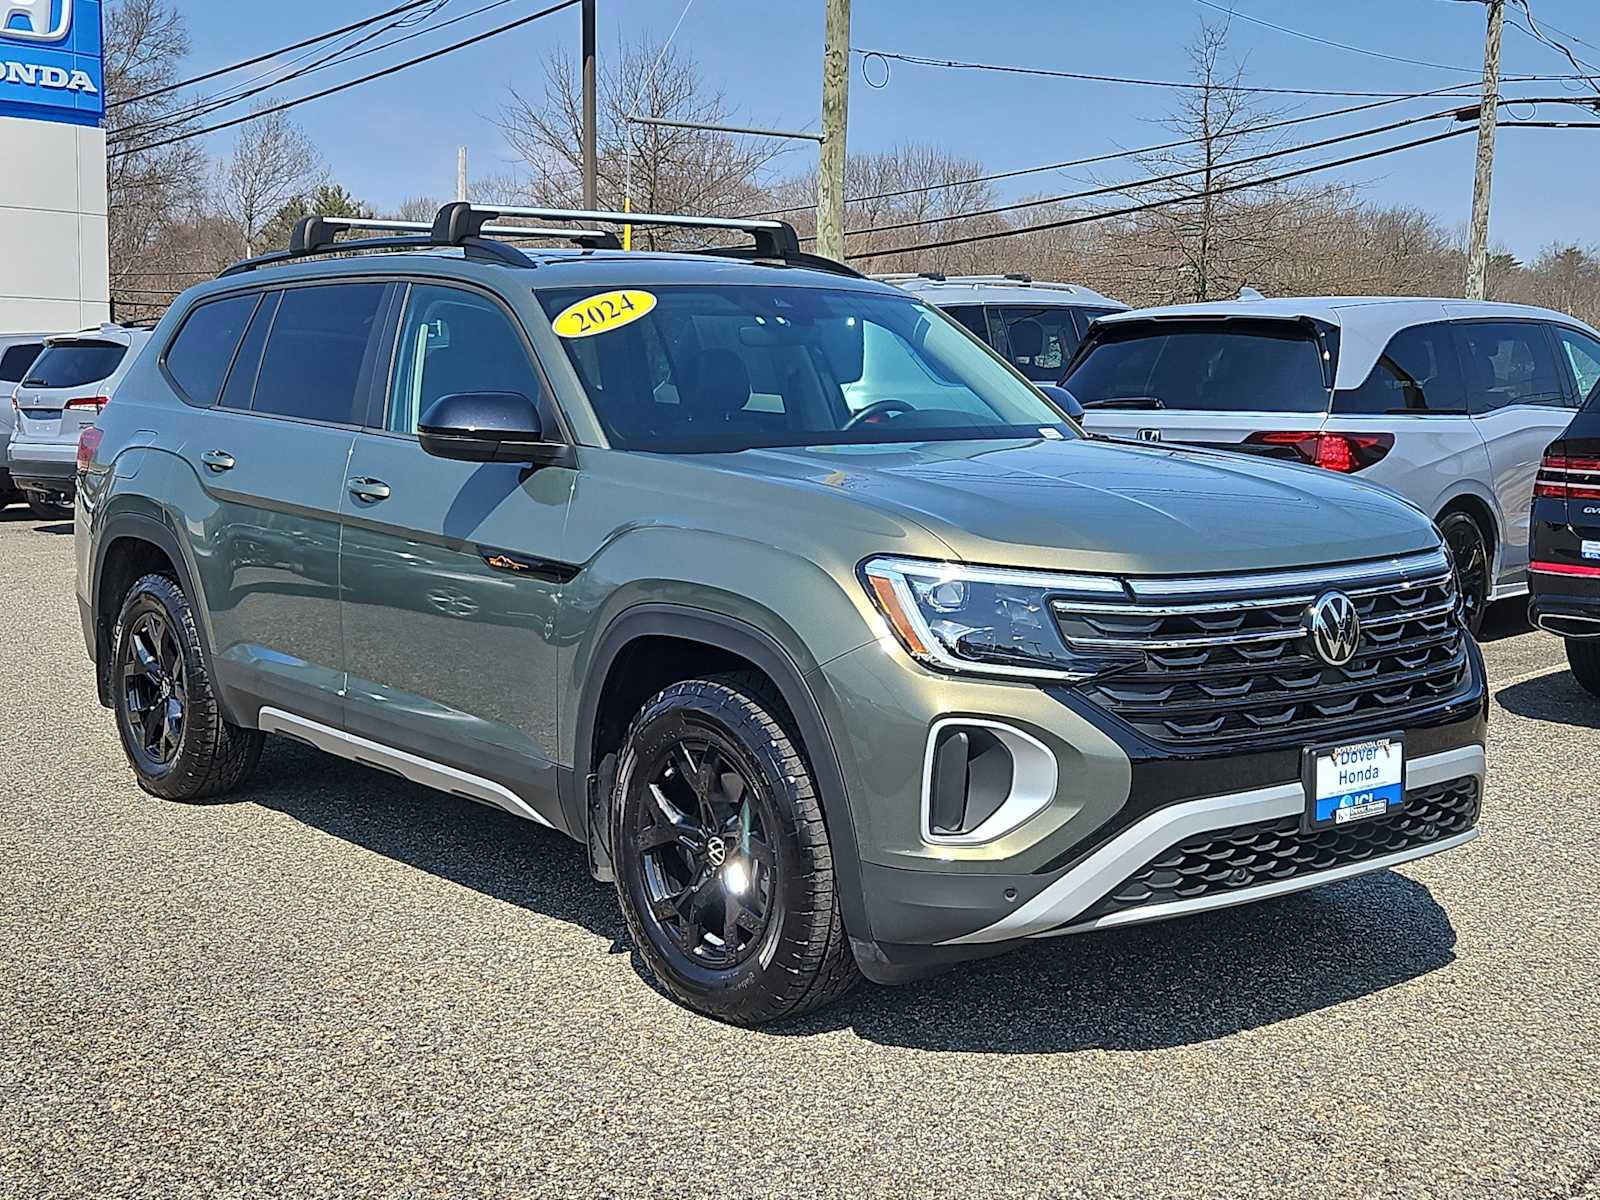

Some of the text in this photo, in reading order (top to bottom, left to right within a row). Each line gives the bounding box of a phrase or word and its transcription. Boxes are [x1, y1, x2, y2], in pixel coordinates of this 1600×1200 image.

[0, 61, 98, 92] NDA
[570, 293, 635, 332] 2024
[1341, 748, 1378, 765] Dover
[1339, 765, 1379, 785] Honda
